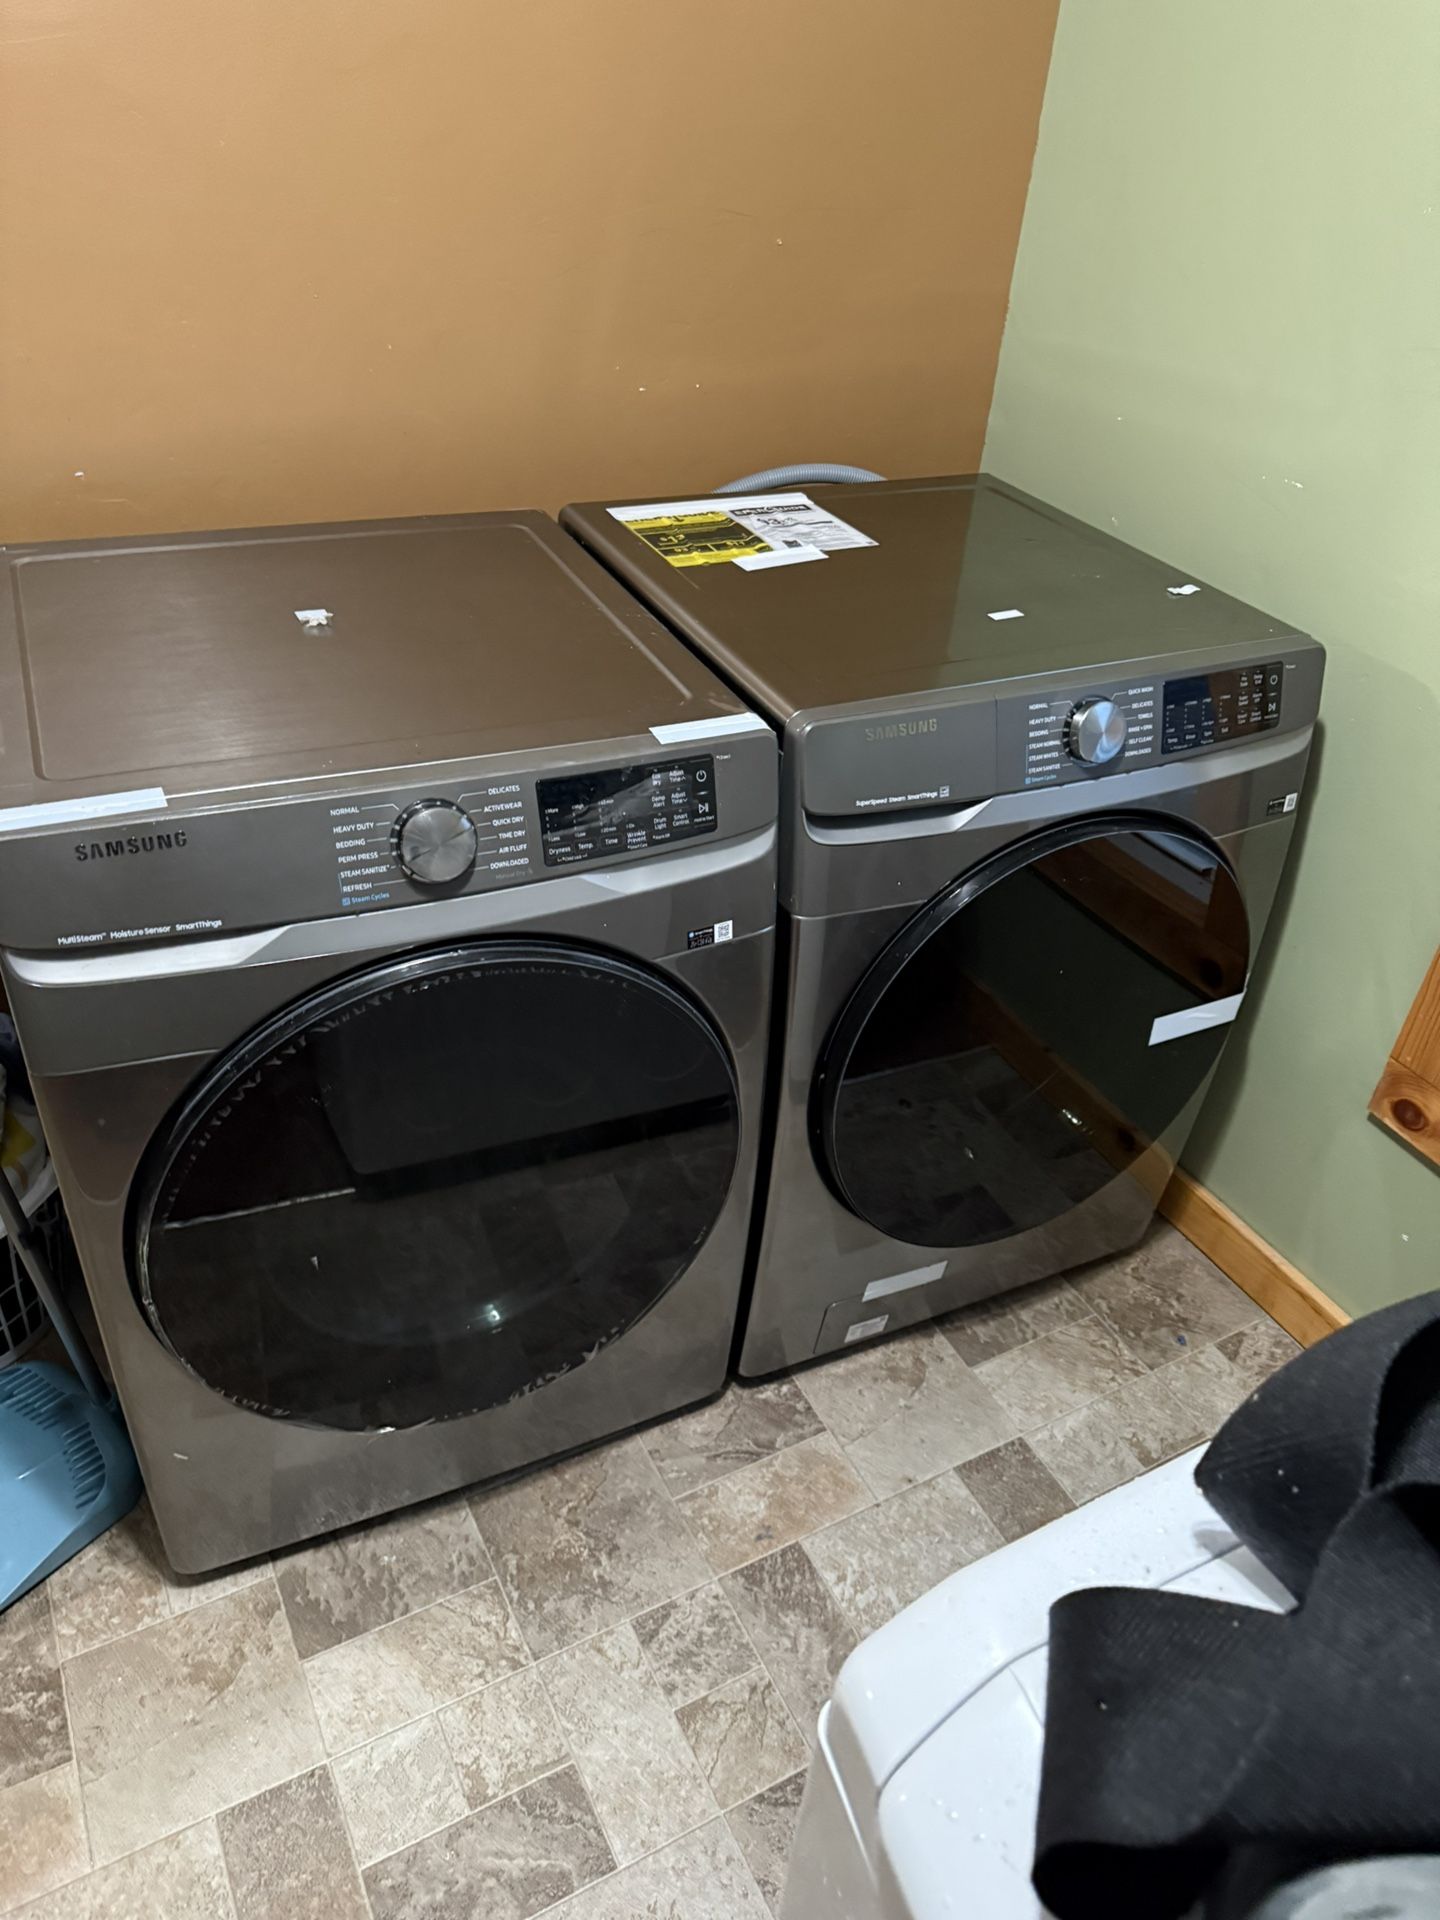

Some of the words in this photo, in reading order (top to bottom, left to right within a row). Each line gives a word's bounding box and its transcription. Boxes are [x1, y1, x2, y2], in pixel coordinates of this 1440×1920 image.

[865, 718, 937, 741] SAMSUNG
[1029, 730, 1049, 738] BEDDING
[488, 785, 520, 795] DELICATES
[907, 791, 938, 800] SmartThings
[330, 806, 359, 816] NORMAL
[484, 801, 522, 813] ACTIVEWEAR
[492, 818, 511, 827] QUICK
[511, 816, 524, 824] DRY
[672, 819, 690, 827] Control
[333, 825, 355, 834] HEAVY
[356, 822, 374, 830] DUTY
[498, 831, 513, 839] TIME
[513, 830, 526, 838] DRY
[627, 830, 646, 838] Wrinkle
[335, 838, 366, 849] BEDDING
[627, 836, 646, 844] Prevent
[74, 831, 187, 862] SAMSUNG
[510, 843, 527, 852] FLUFF
[548, 846, 571, 855] Dryness
[338, 855, 357, 863] PERM
[358, 851, 378, 860] PRESS
[490, 857, 529, 870] DOWNLOADED
[340, 870, 361, 878] STEAM
[343, 882, 372, 893] REFRESH
[352, 895, 370, 903] Steam
[371, 892, 390, 901] Cycles
[110, 928, 144, 939] Moisture
[144, 925, 171, 935] Sensor
[175, 919, 222, 931] SmartThings
